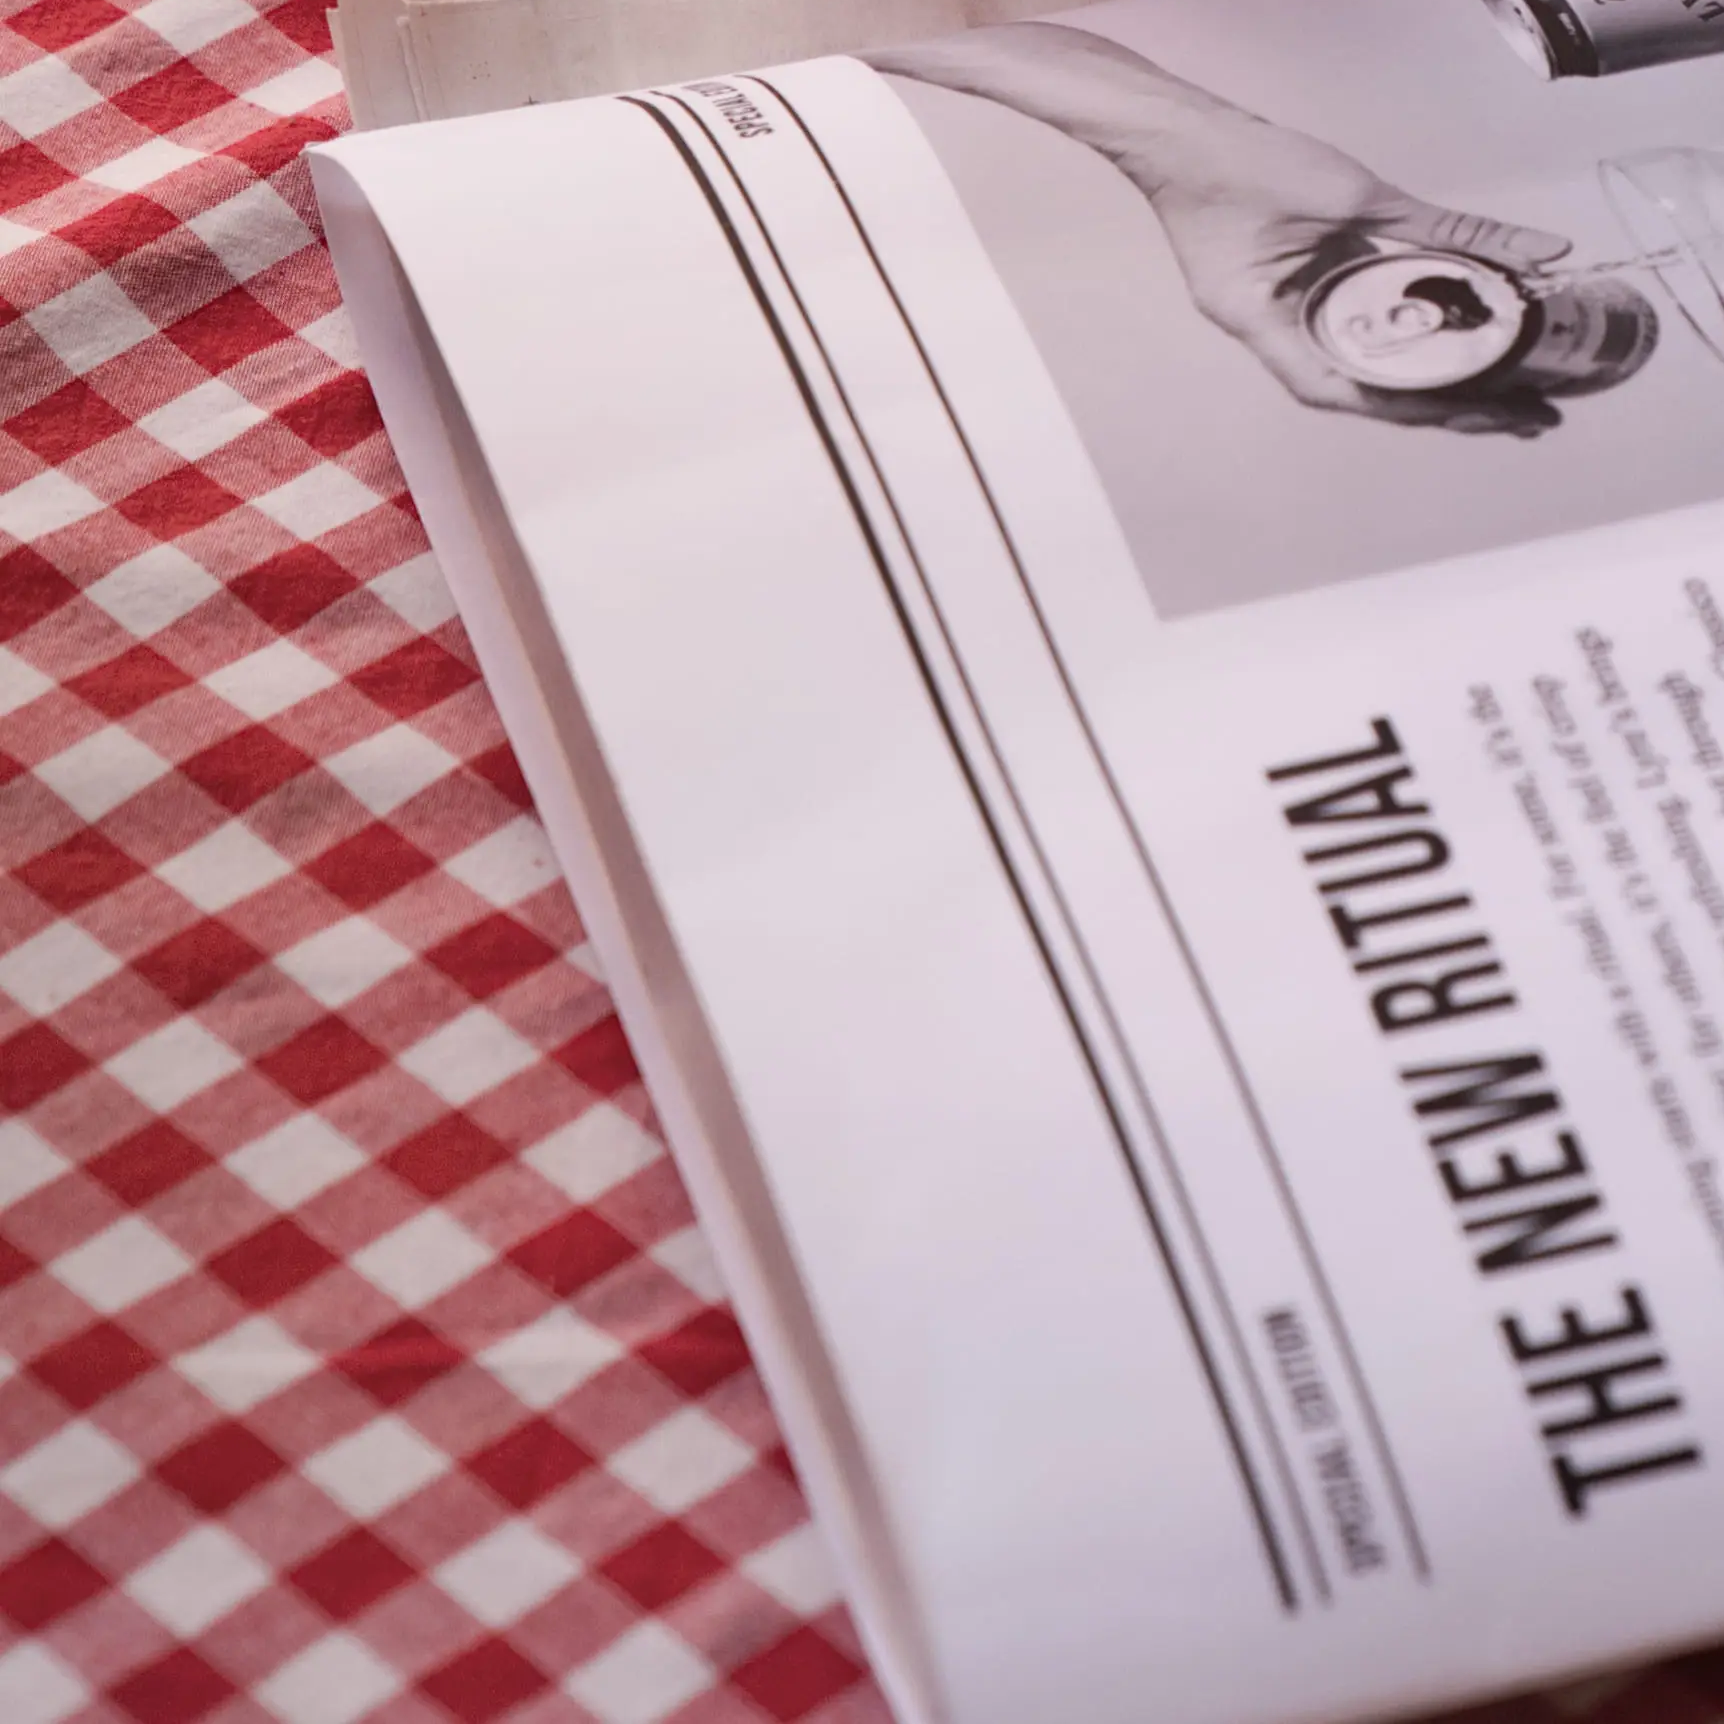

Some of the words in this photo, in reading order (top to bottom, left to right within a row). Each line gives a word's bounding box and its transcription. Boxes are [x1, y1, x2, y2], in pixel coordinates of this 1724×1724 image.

[712, 93, 775, 140] SPECIAL
[1264, 716, 1520, 1037] RITUAL
[1398, 1051, 1622, 1276] NEW
[1501, 1284, 1704, 1518] THE
